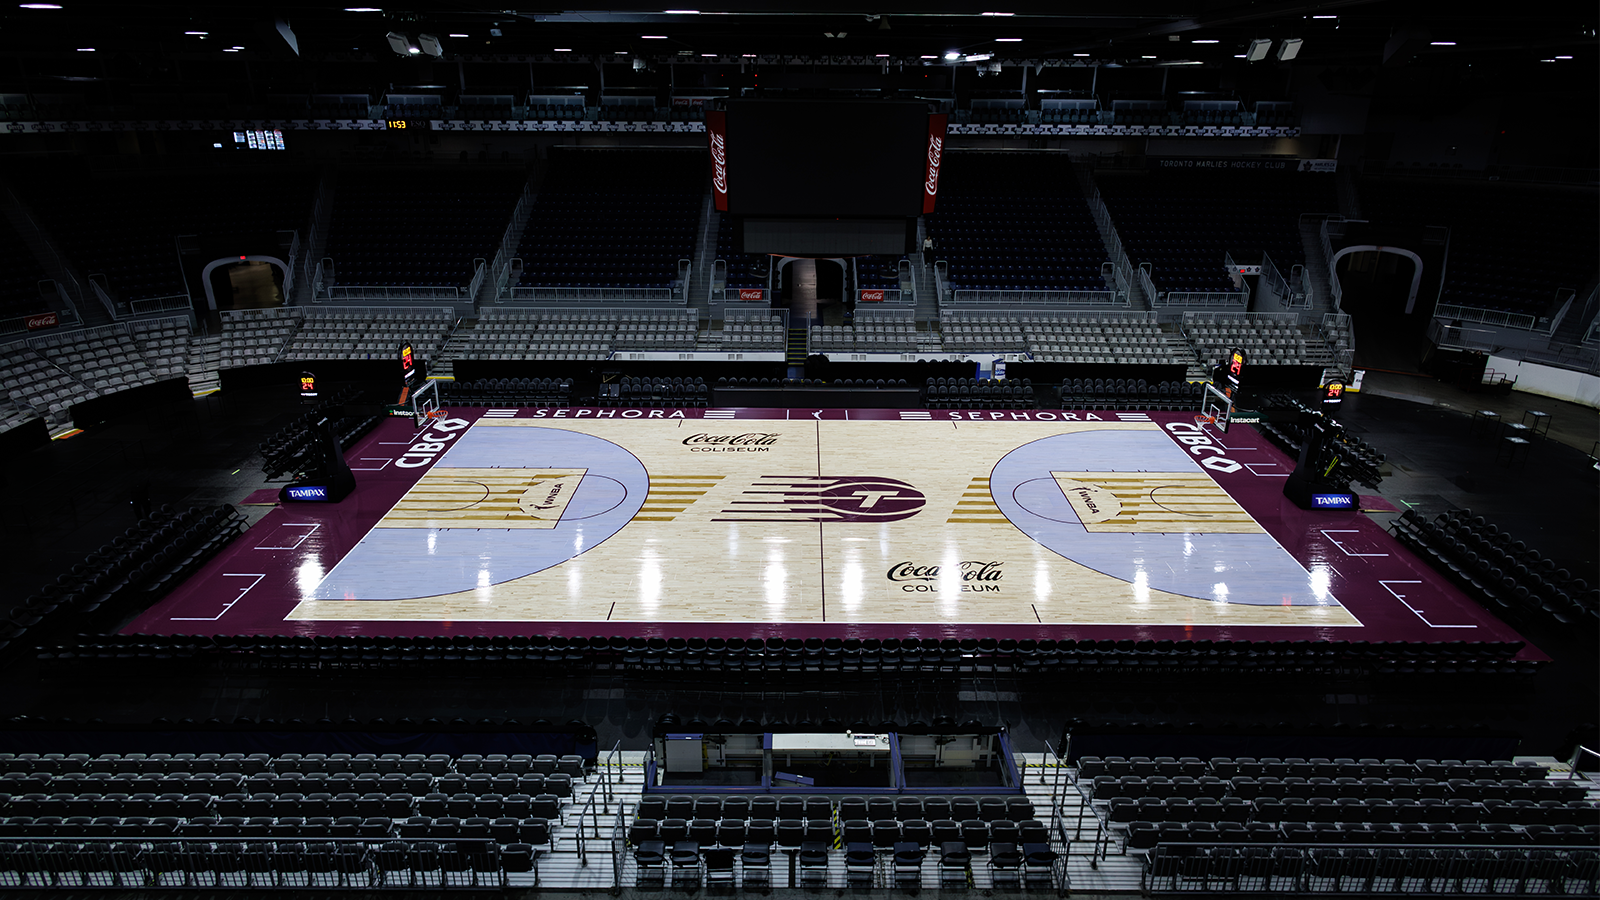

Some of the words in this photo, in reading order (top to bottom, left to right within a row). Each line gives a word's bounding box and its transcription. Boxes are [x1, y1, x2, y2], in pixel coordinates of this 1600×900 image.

[710, 130, 728, 194] Coca-Cola
[925, 134, 942, 196] Coca-Cola
[1160, 160, 1193, 168] TORONTO
[1196, 160, 1228, 168] MARLIES
[1231, 161, 1262, 169] HOCKEY
[1265, 161, 1286, 169] CLUB
[28, 315, 56, 328] Coca-Cola
[1328, 389, 1340, 397] 24
[533, 409, 686, 418] SEPHORA
[949, 412, 1103, 420] SEPHORA
[682, 432, 782, 446] Coca-Cola
[289, 489, 325, 498] TAMPAX
[543, 483, 564, 506] WNBA
[851, 490, 900, 508] T
[1079, 491, 1100, 514] WNBA
[1315, 497, 1351, 505] TAMPAX
[902, 585, 1000, 593] COLEUM
